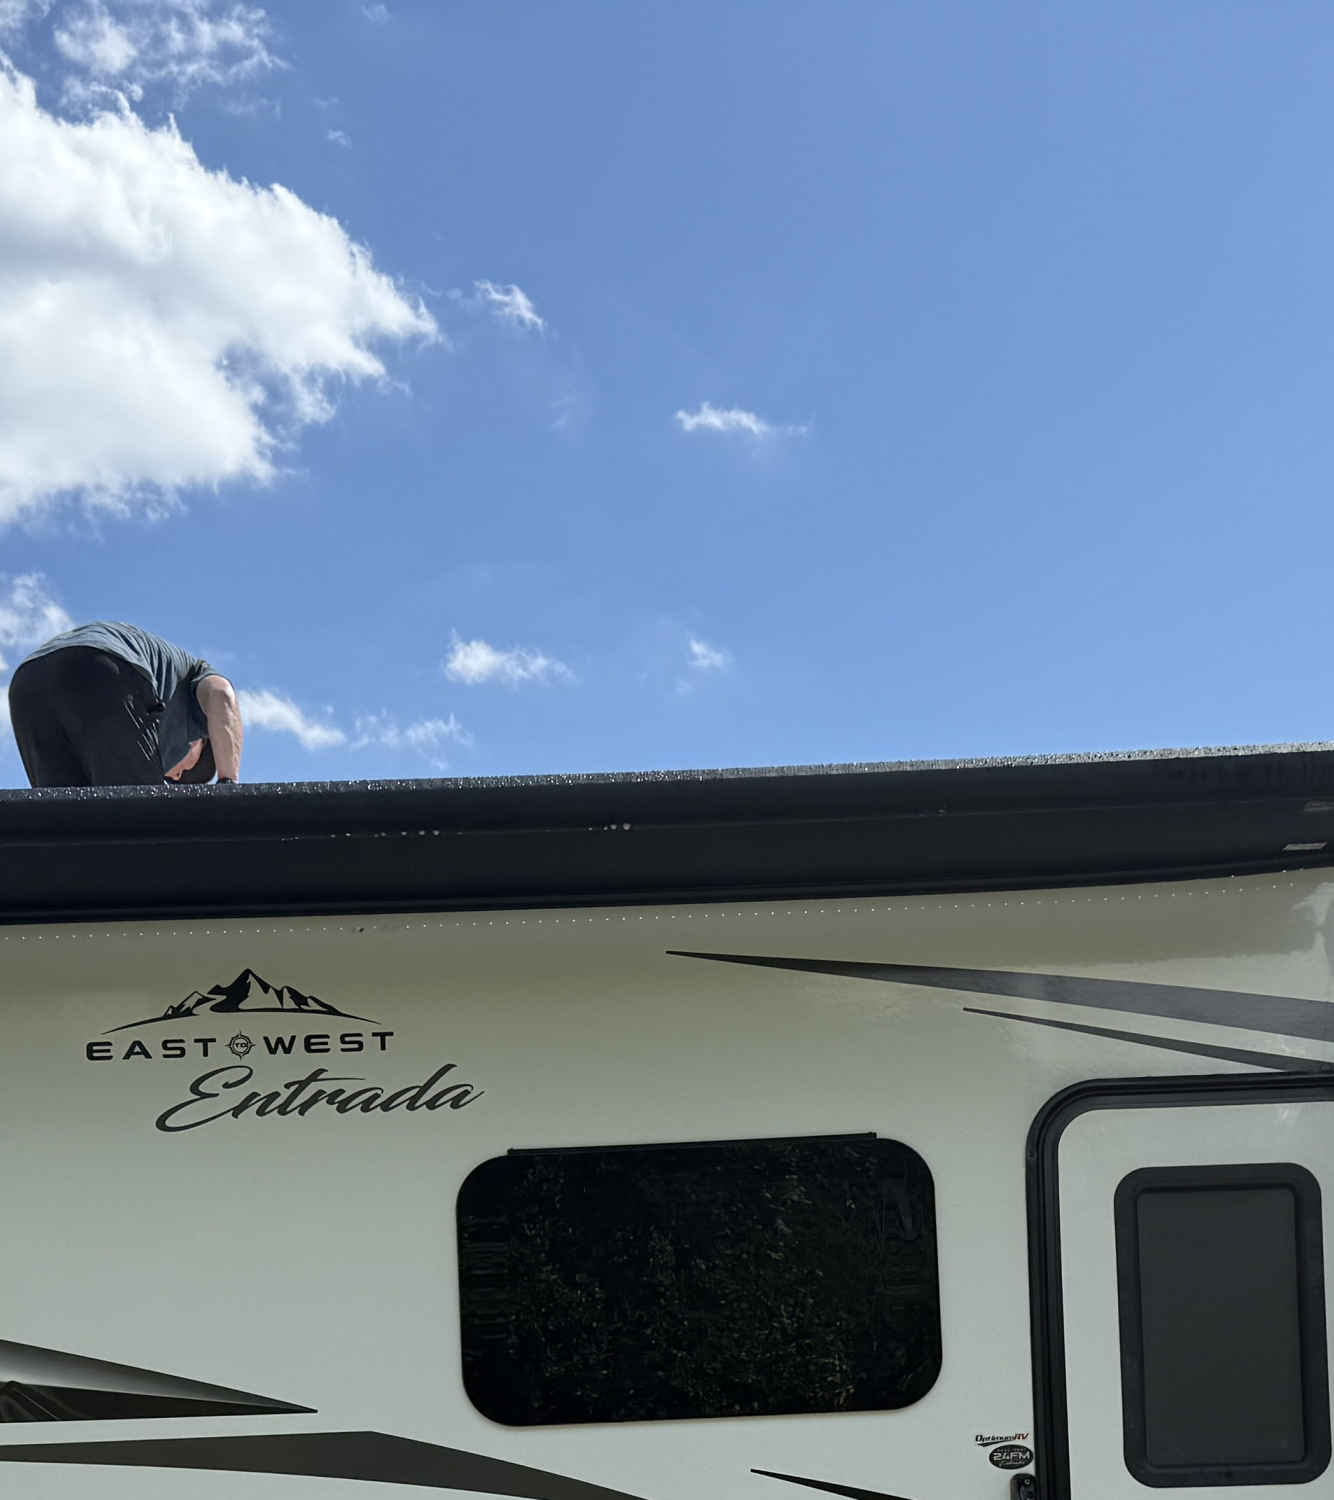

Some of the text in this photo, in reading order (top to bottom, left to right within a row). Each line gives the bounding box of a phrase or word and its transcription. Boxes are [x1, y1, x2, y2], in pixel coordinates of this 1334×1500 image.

[86, 1037, 217, 1061] EAST
[263, 1031, 395, 1056] WEST
[155, 1063, 485, 1133] Entrada
[993, 1451, 1031, 1461] 24FM
